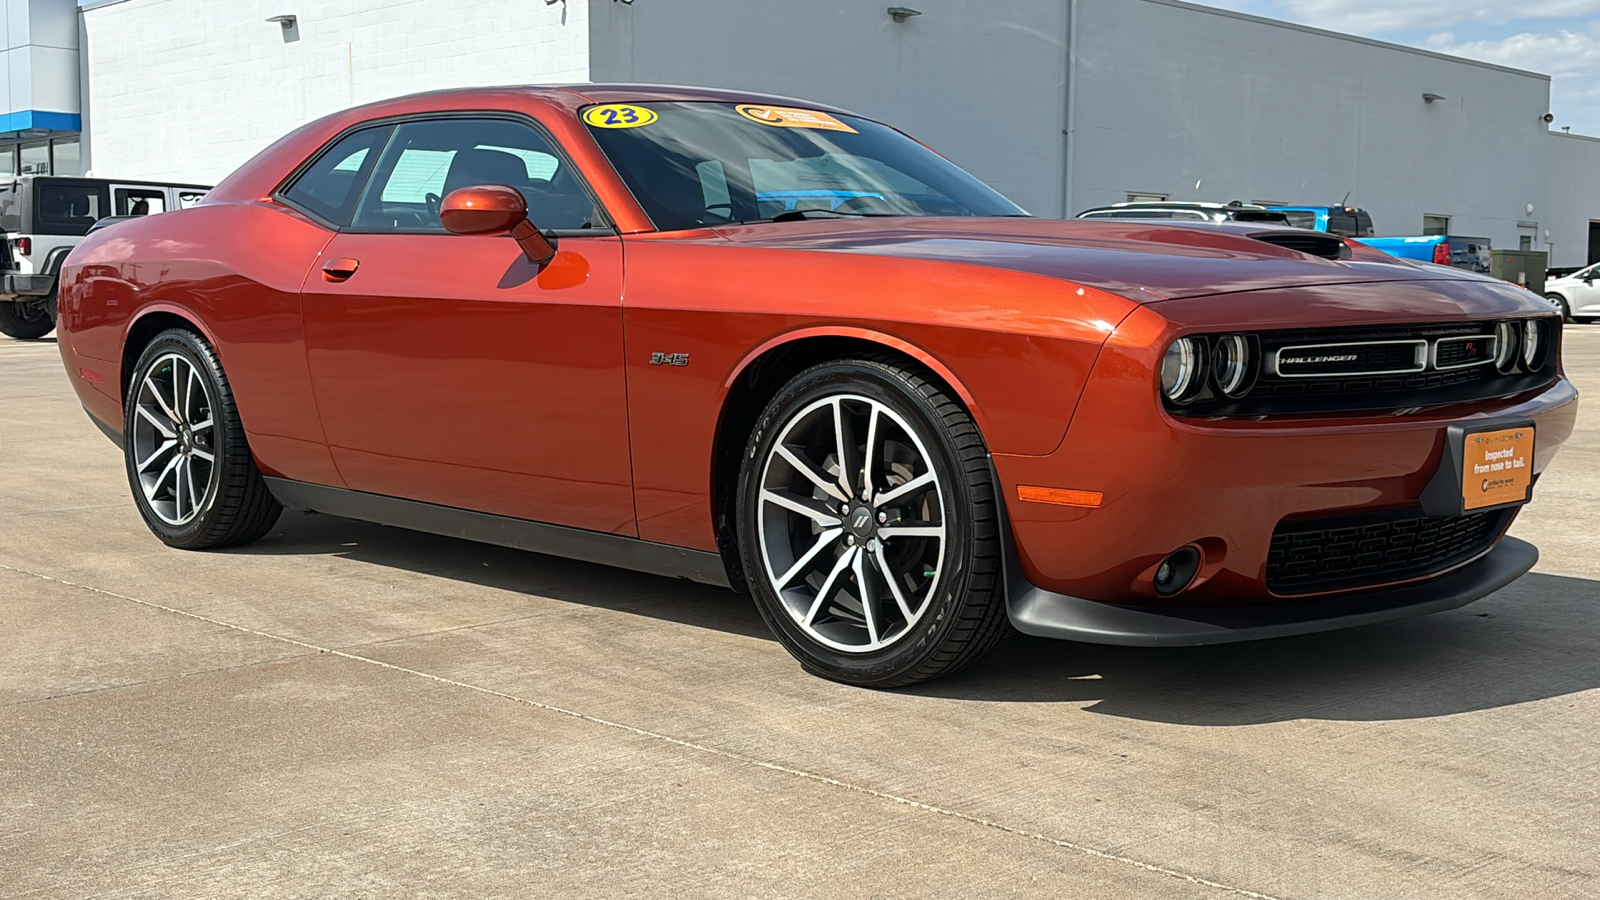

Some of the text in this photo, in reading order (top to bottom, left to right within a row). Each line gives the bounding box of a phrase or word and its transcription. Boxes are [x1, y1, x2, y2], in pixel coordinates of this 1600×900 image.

[600, 107, 640, 125] 23
[649, 352, 689, 366] 345
[1485, 447, 1514, 462] Inspected
[1474, 456, 1525, 474] from nose to tail.
